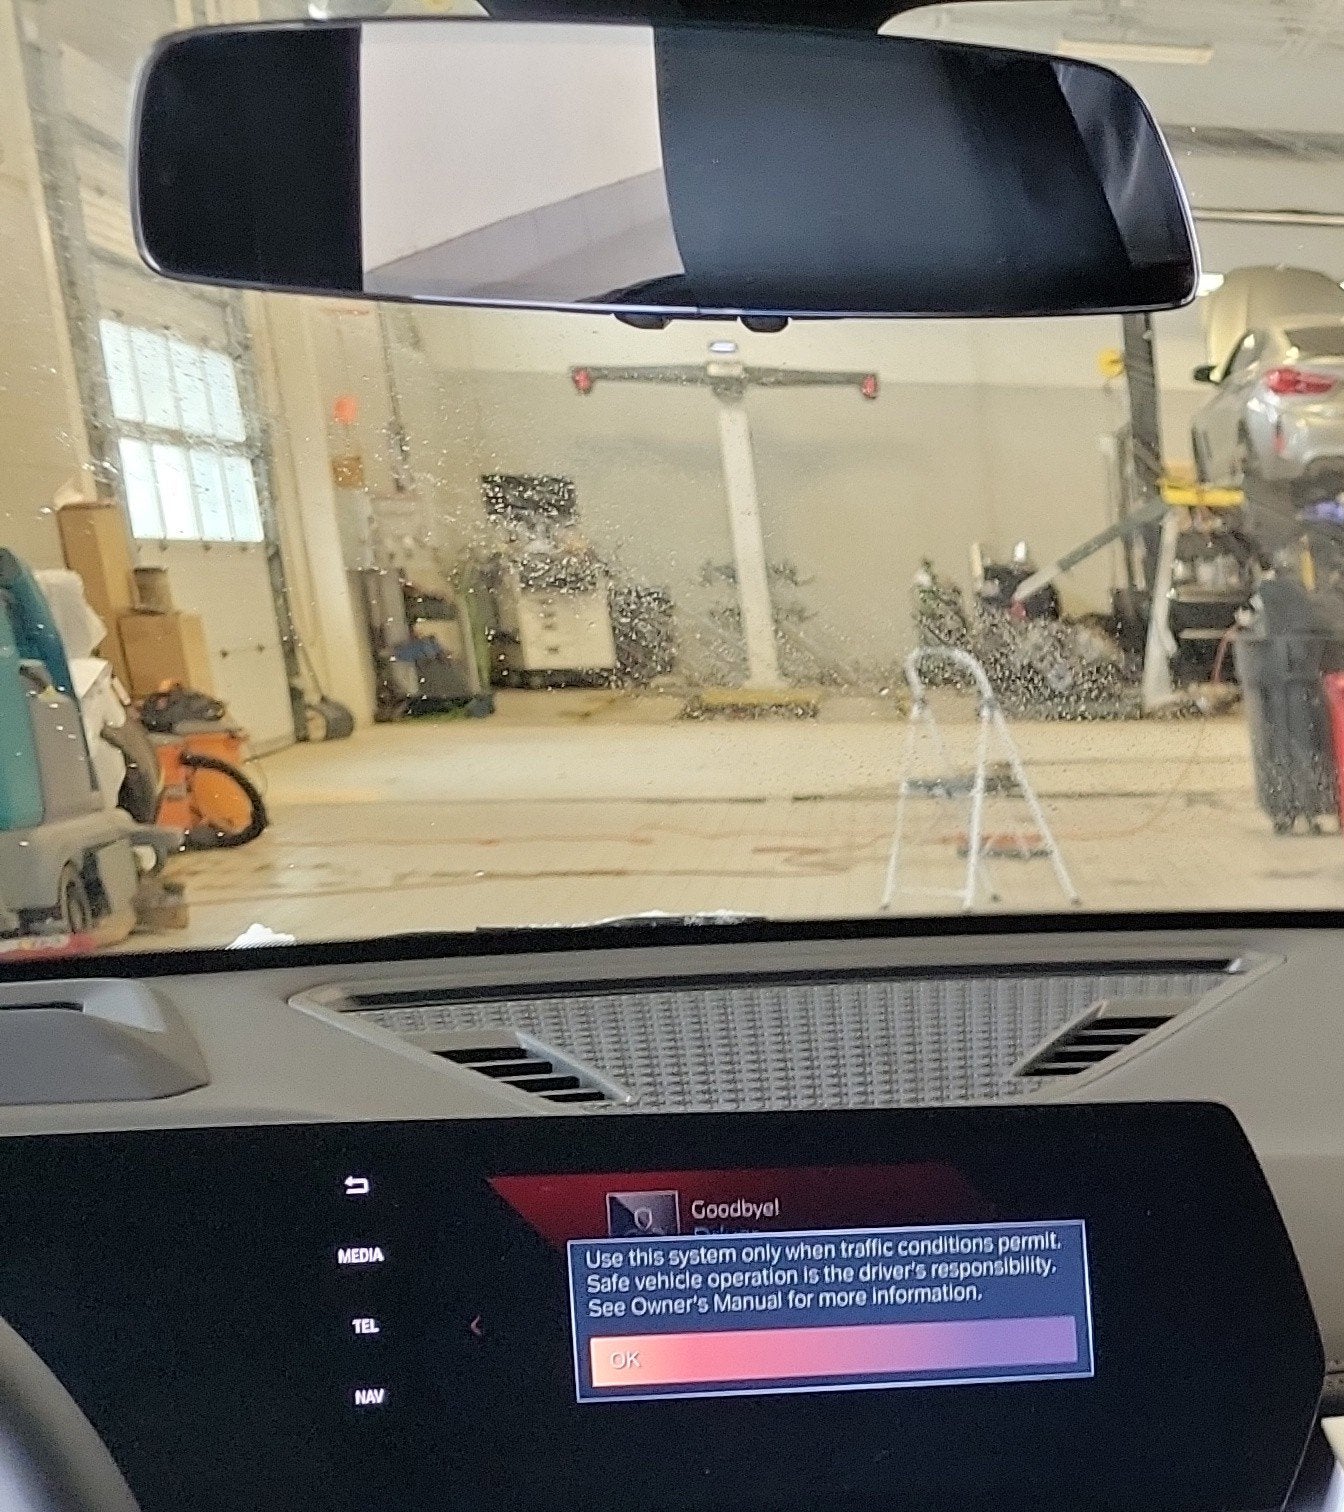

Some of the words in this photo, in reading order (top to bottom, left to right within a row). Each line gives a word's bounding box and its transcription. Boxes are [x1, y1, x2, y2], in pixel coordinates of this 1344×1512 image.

[691, 1197, 780, 1220] Goodbye!
[337, 1247, 385, 1264] MEDIA
[585, 1249, 624, 1269] Use
[628, 1247, 665, 1267] this
[668, 1246, 737, 1269] system
[741, 1242, 782, 1266] only
[785, 1242, 836, 1260] when
[840, 1237, 893, 1257] traffic
[897, 1234, 995, 1257] conditions
[998, 1230, 1062, 1255] permit.
[586, 1272, 630, 1294] Safe
[635, 1269, 701, 1291] vehicle
[707, 1265, 798, 1292] operation
[803, 1265, 820, 1282] is
[823, 1263, 855, 1283] the
[858, 1260, 927, 1282] driver's
[931, 1255, 1057, 1281] responsibility.
[588, 1297, 626, 1318] See
[631, 1294, 709, 1317] Owner's
[713, 1291, 783, 1313] Manual
[788, 1289, 815, 1308] for
[819, 1289, 867, 1308] more
[872, 1283, 983, 1305] information.
[352, 1318, 380, 1334] TEL
[609, 1349, 641, 1370] OK
[355, 1388, 385, 1405] NAV
